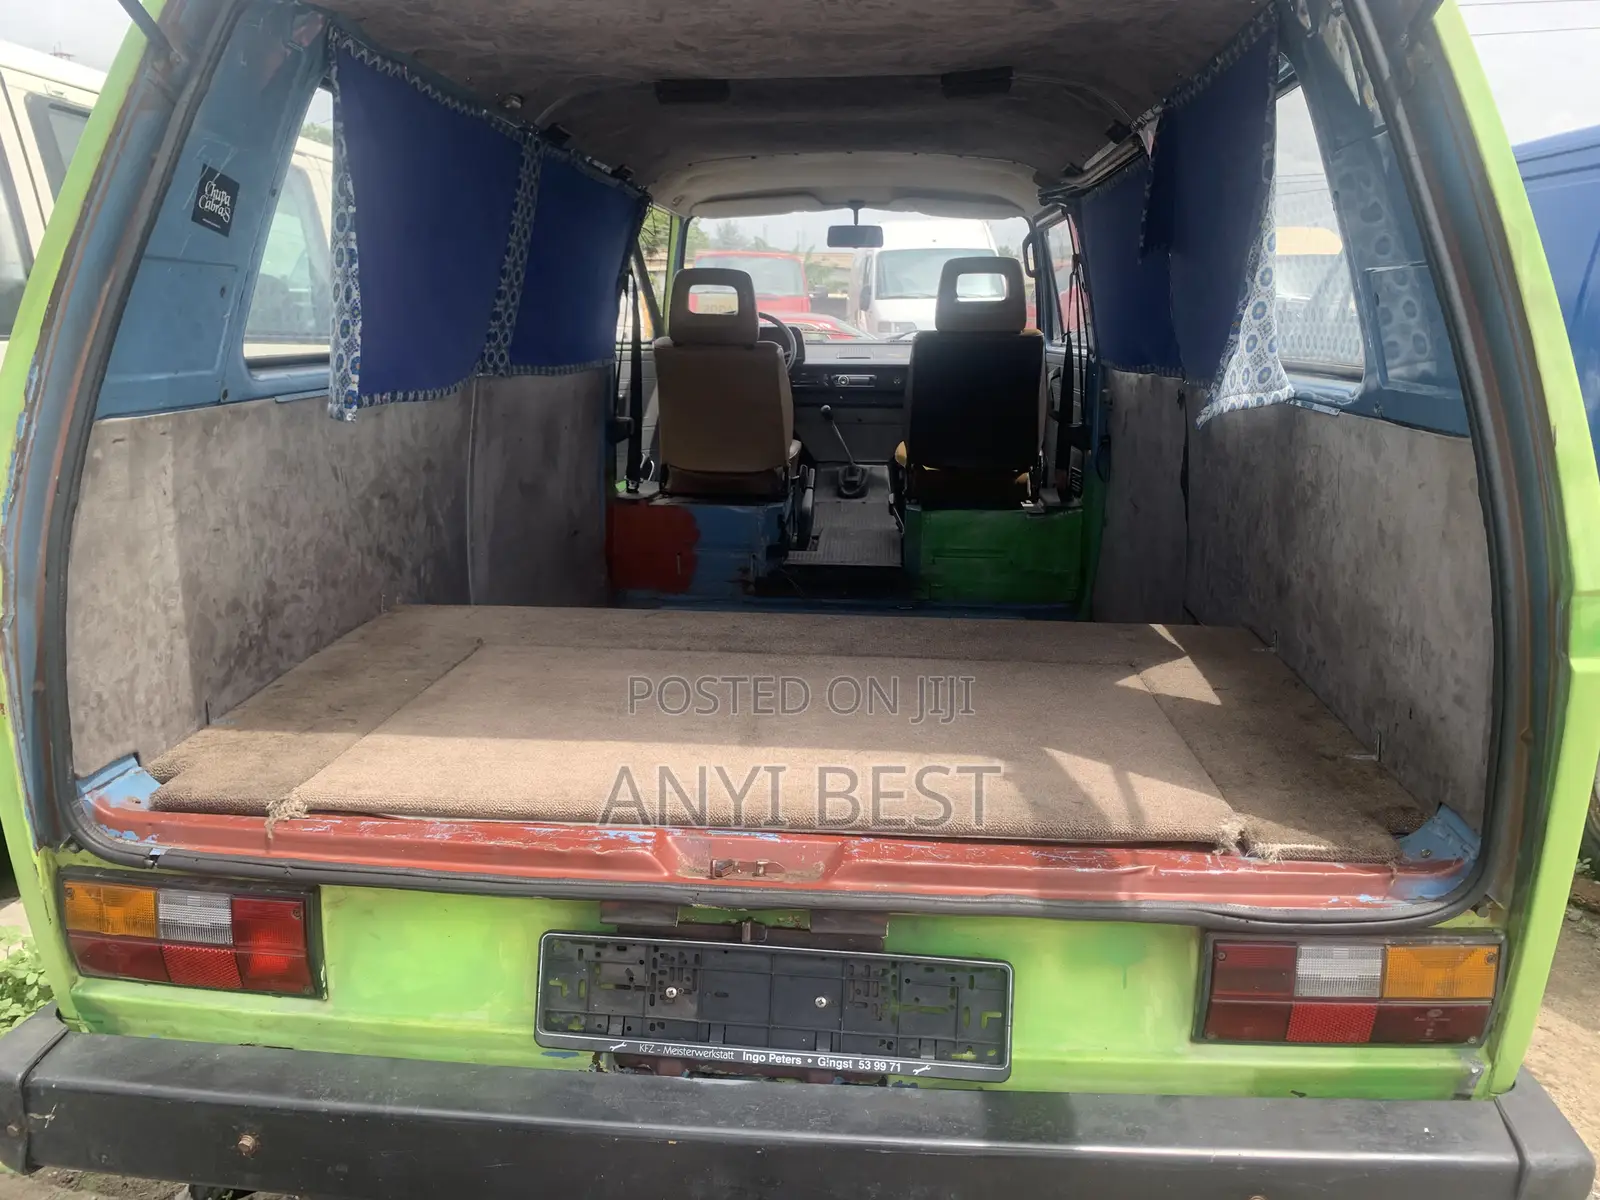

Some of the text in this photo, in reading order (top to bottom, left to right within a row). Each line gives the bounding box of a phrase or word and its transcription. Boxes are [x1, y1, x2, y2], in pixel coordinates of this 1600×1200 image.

[205, 181, 231, 206] Chupa
[639, 1044, 655, 1054] KFZ
[663, 1046, 735, 1060] Meisterwerkstatt
[743, 1051, 766, 1064] Ingo
[768, 1053, 802, 1065] Peters
[858, 1060, 871, 1070] 53
[873, 1061, 887, 1072] 99
[889, 1062, 901, 1073] 71
